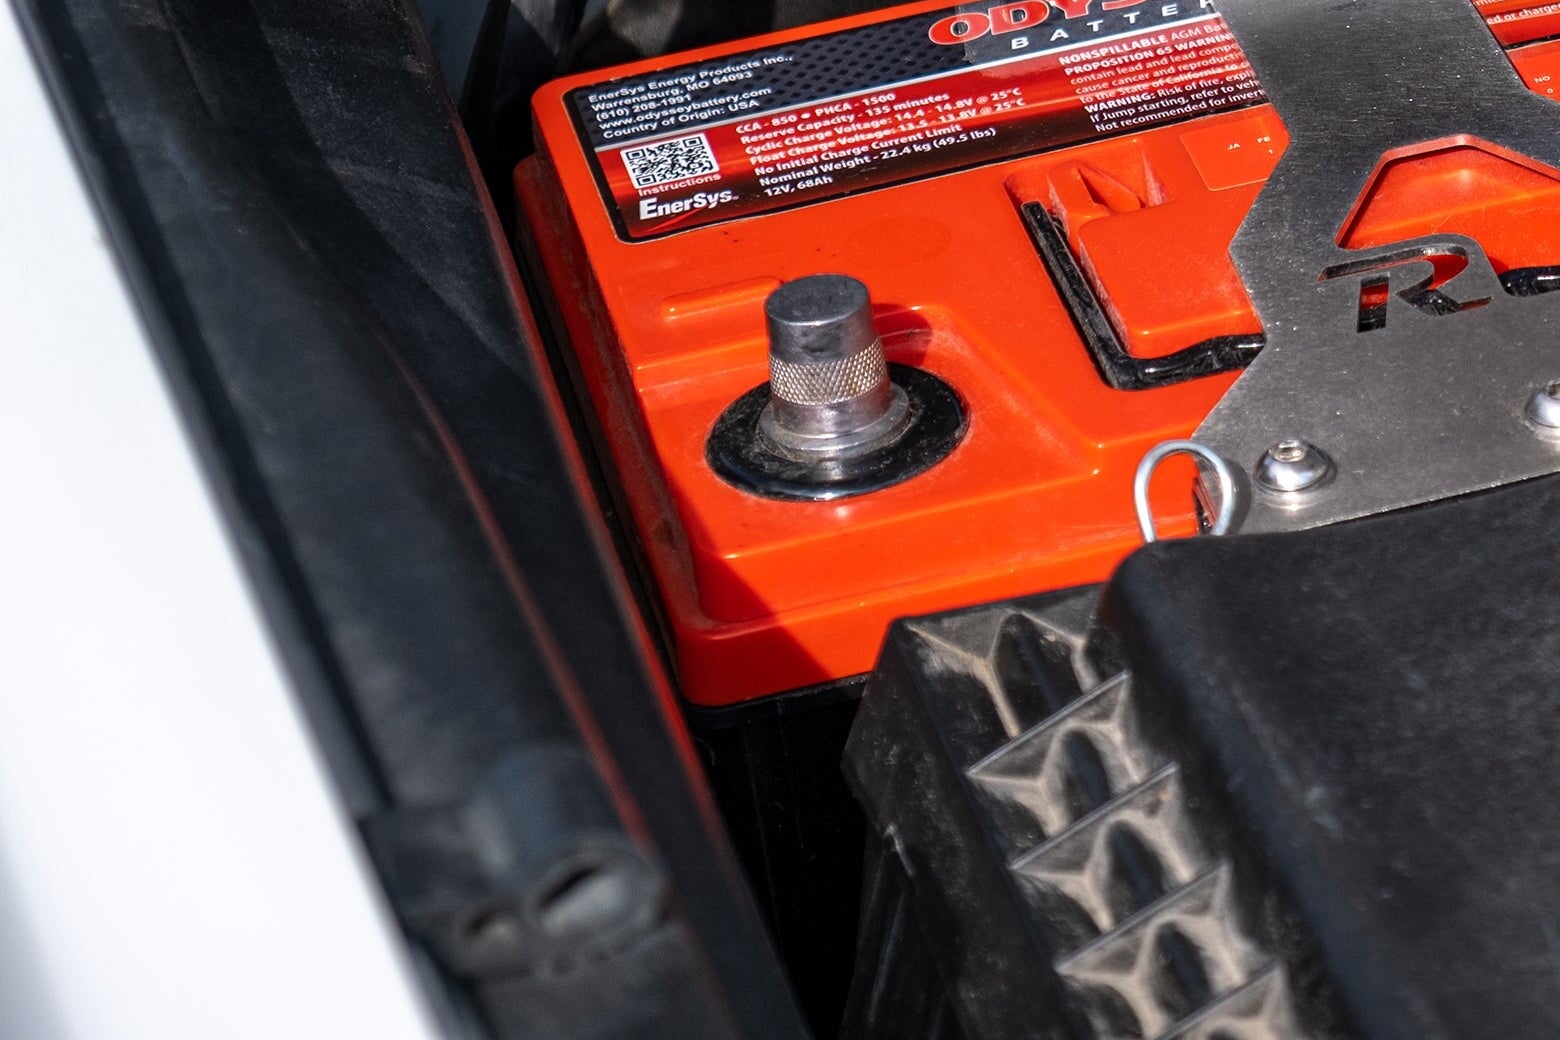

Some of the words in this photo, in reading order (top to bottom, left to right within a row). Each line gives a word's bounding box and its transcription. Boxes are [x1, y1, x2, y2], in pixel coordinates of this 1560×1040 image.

[1058, 33, 1168, 65] NONSPILLABLE
[1169, 27, 1202, 41] AGM
[1064, 49, 1154, 75] PROPOSITION
[1155, 45, 1173, 55] 65
[1174, 32, 1233, 51] WARNIN
[1069, 69, 1116, 85] contain
[1116, 62, 1143, 75] lead
[1144, 56, 1168, 68] and
[1169, 50, 1196, 63] lead
[587, 84, 645, 103] EnerSys
[648, 74, 696, 90] Energy
[698, 59, 760, 78] Products
[591, 85, 684, 112] Warrensburg,
[686, 80, 709, 91] MO
[711, 70, 753, 85] 64093
[1074, 81, 1109, 95] cause
[1110, 72, 1150, 86] cancer
[1151, 65, 1175, 77] and
[1079, 94, 1093, 104] to
[1095, 89, 1116, 100] the
[1117, 81, 1149, 95] State
[1150, 78, 1164, 88] of
[1164, 65, 1223, 84] California
[1224, 62, 1238, 71] to
[1084, 91, 1155, 113] WARNING:
[1156, 85, 1183, 97] Risk
[1183, 81, 1197, 91] of
[1198, 75, 1223, 88] fire,
[1224, 70, 1252, 83] expl
[1089, 113, 1101, 122] If
[1101, 105, 1136, 121] Jump
[1136, 94, 1189, 113] starting,
[1189, 87, 1218, 100] refer
[1220, 84, 1234, 93] to
[1235, 78, 1259, 90] veh
[595, 107, 629, 121] (610)
[631, 93, 692, 113] 208-1991
[598, 87, 772, 130] www.odysseybattery.com
[602, 120, 658, 139] Country
[660, 116, 675, 126] of
[677, 106, 725, 124] Origin:
[728, 98, 759, 112] USA
[734, 121, 762, 134] CCA
[770, 113, 798, 126] 850
[814, 102, 853, 117] PHCA
[861, 92, 896, 106] 1500
[740, 125, 796, 144] Reserve
[796, 112, 856, 133] Capacity
[864, 105, 891, 117] 135
[891, 91, 950, 111] minutes
[744, 139, 783, 156] Cyclic
[783, 128, 834, 147] Charge
[833, 115, 893, 136] Voltage:
[893, 108, 925, 122] 14.4
[934, 97, 974, 113] 14.8V
[989, 87, 1022, 101] 25°C
[1094, 120, 1119, 132] Not
[1119, 100, 1207, 126] recommended
[1208, 96, 1226, 107] for
[1228, 88, 1264, 102] invert
[749, 150, 786, 165] Float
[786, 139, 837, 158] Charge
[836, 126, 897, 147] Voltage:
[897, 119, 929, 132] 13.5
[938, 108, 977, 124] 13.8V
[753, 164, 775, 176] No
[775, 154, 819, 171] Initial
[819, 143, 870, 162] Charge
[870, 131, 923, 150] Current
[924, 122, 963, 138] Limit
[758, 166, 819, 187] Nominal
[818, 154, 872, 174] Weight
[879, 145, 912, 160] 22.4
[912, 141, 932, 153] kg
[931, 132, 969, 149] (49.5
[969, 126, 996, 140] lbs)
[637, 171, 722, 197] Instructions
[763, 182, 796, 198] 12V,
[795, 174, 833, 190] 68Ah
